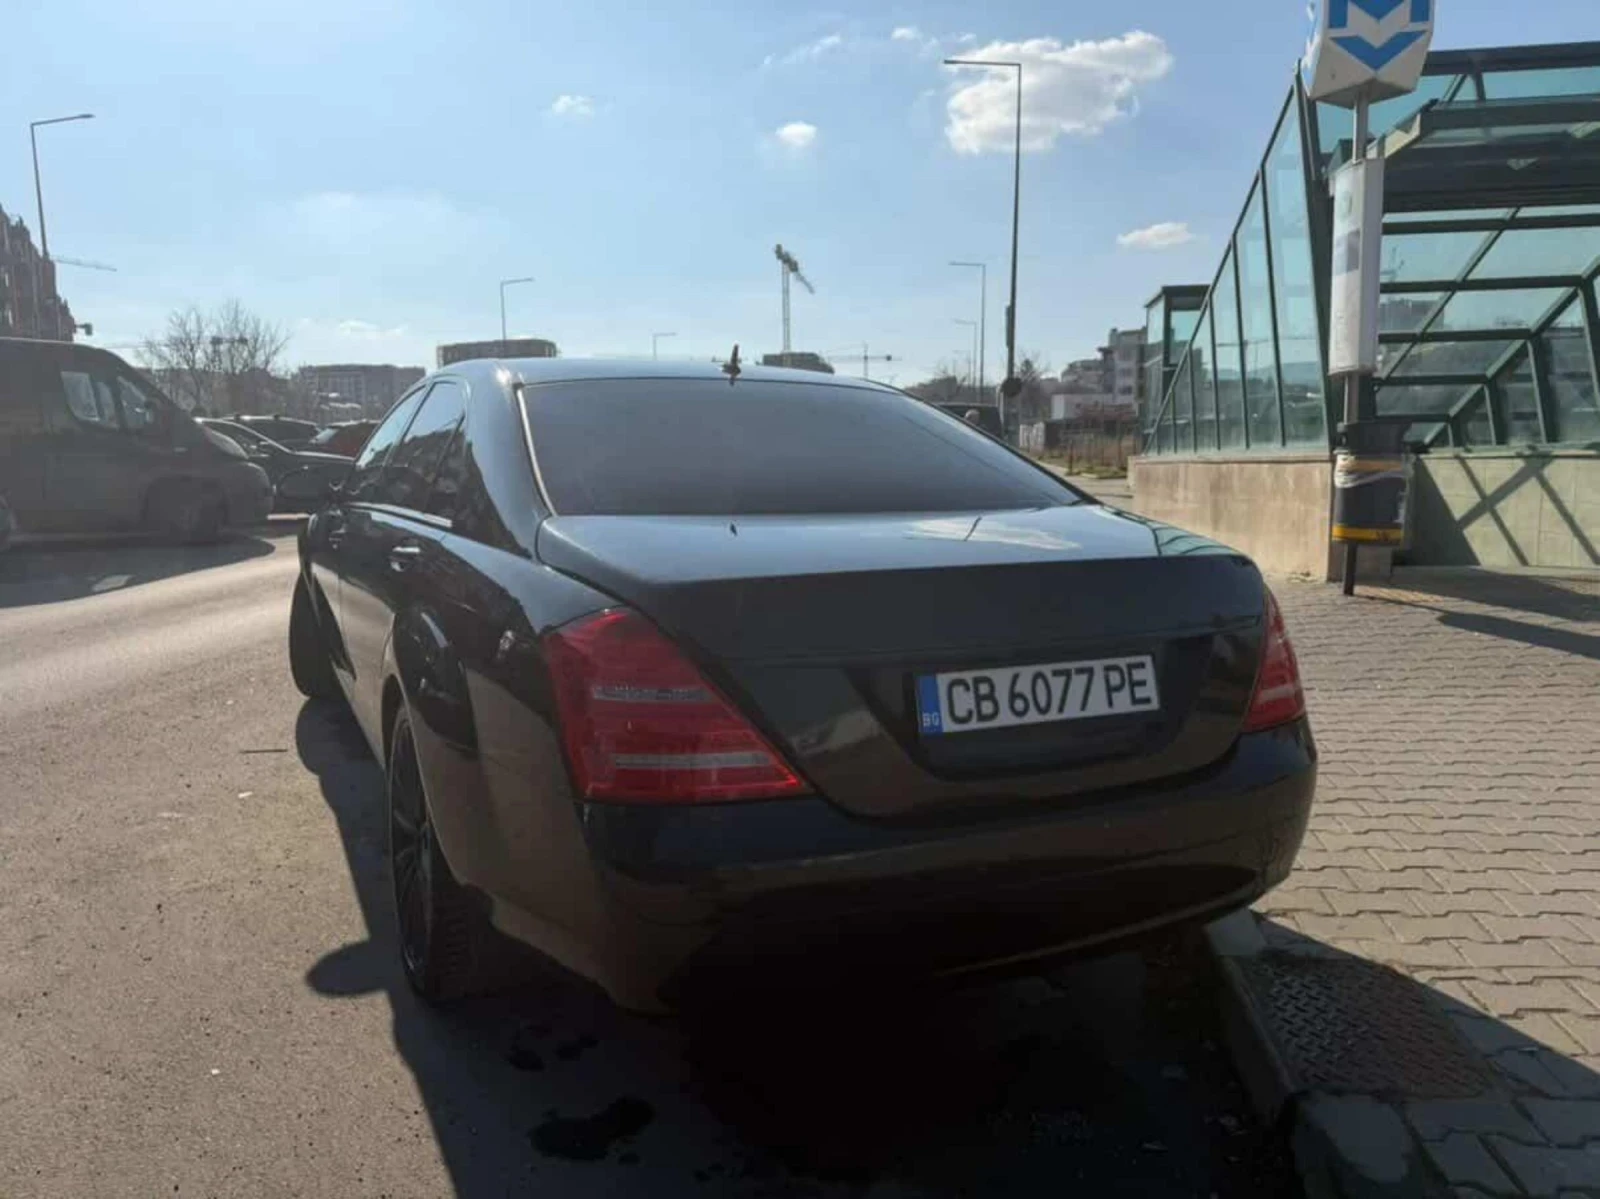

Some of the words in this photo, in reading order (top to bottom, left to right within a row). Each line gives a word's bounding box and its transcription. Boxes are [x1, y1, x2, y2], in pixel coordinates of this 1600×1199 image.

[947, 676, 999, 725] CB
[1008, 666, 1094, 718] 6077
[1103, 662, 1152, 709] PE
[922, 712, 940, 727] BG
